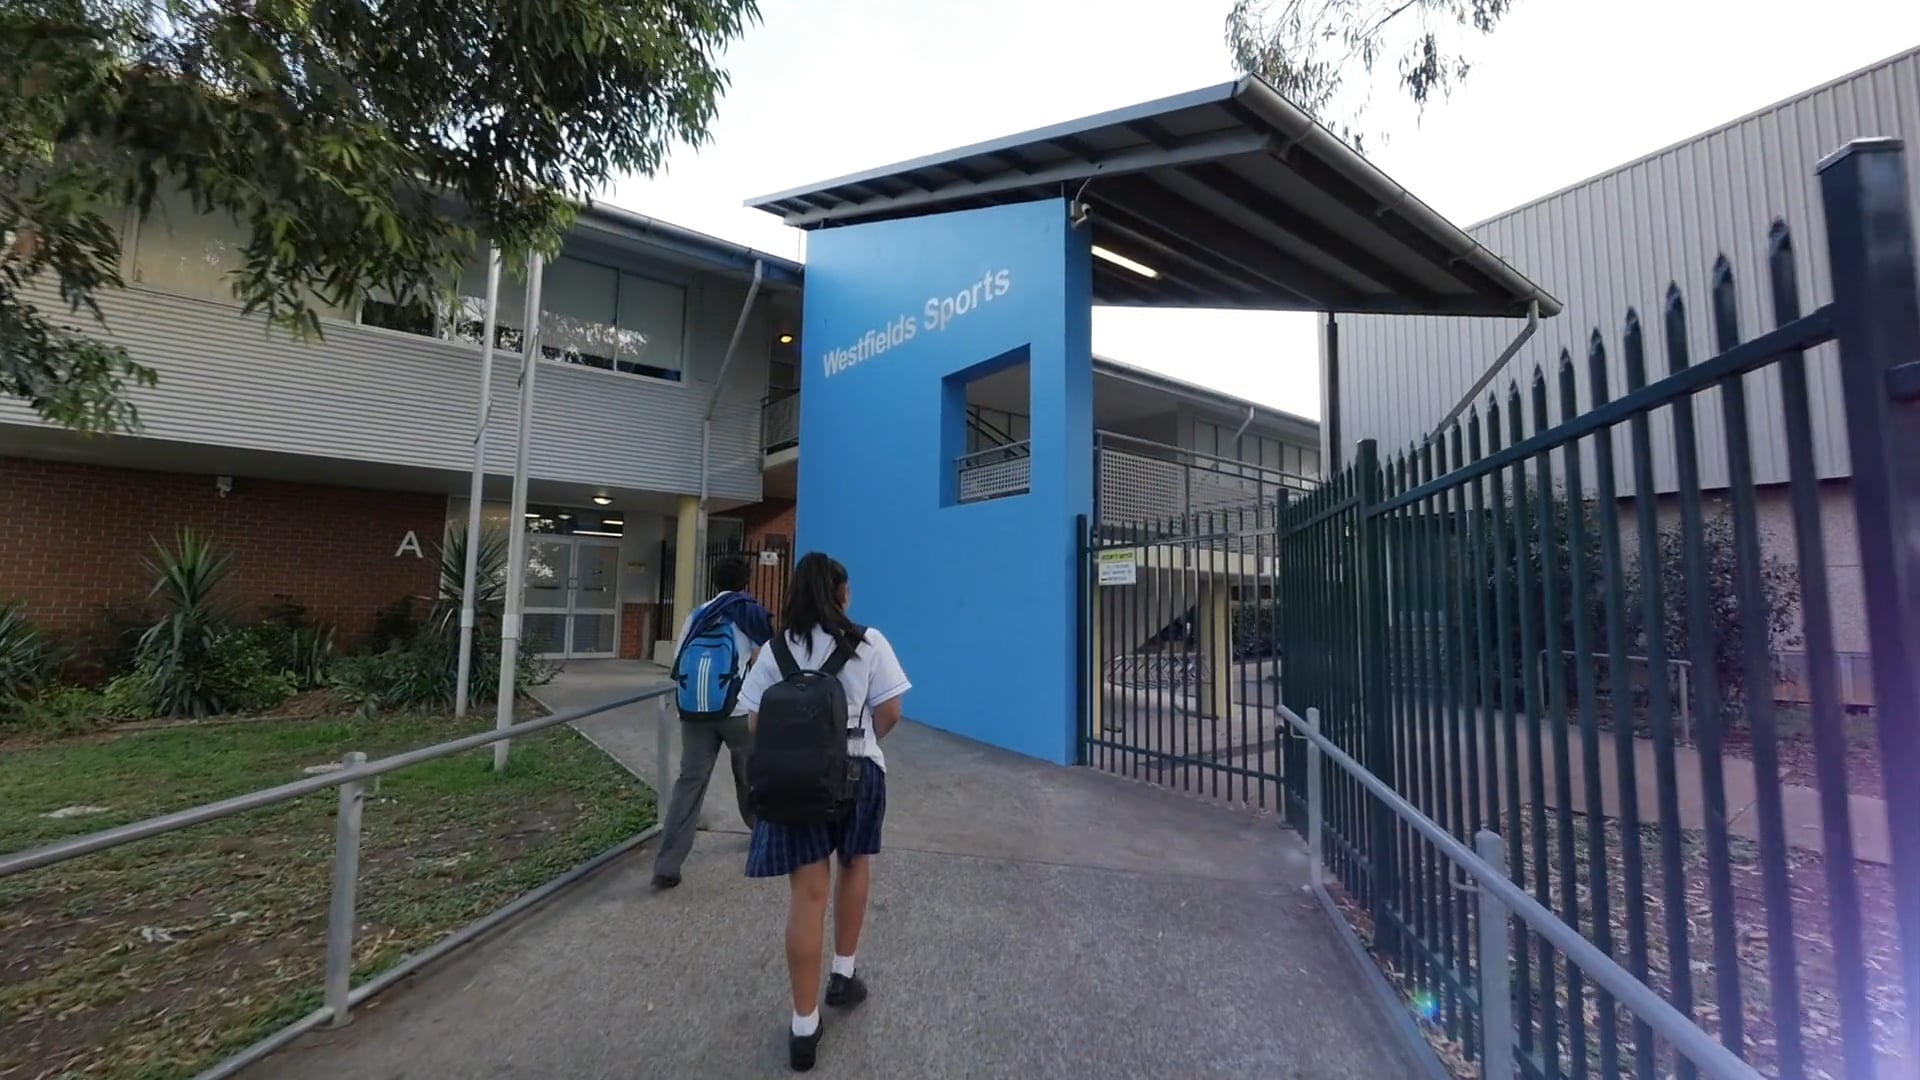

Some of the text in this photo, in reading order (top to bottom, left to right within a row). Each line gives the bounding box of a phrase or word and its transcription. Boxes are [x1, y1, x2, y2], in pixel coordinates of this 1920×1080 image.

[823, 268, 1010, 378] Westfields Sports
[395, 530, 424, 558] A
